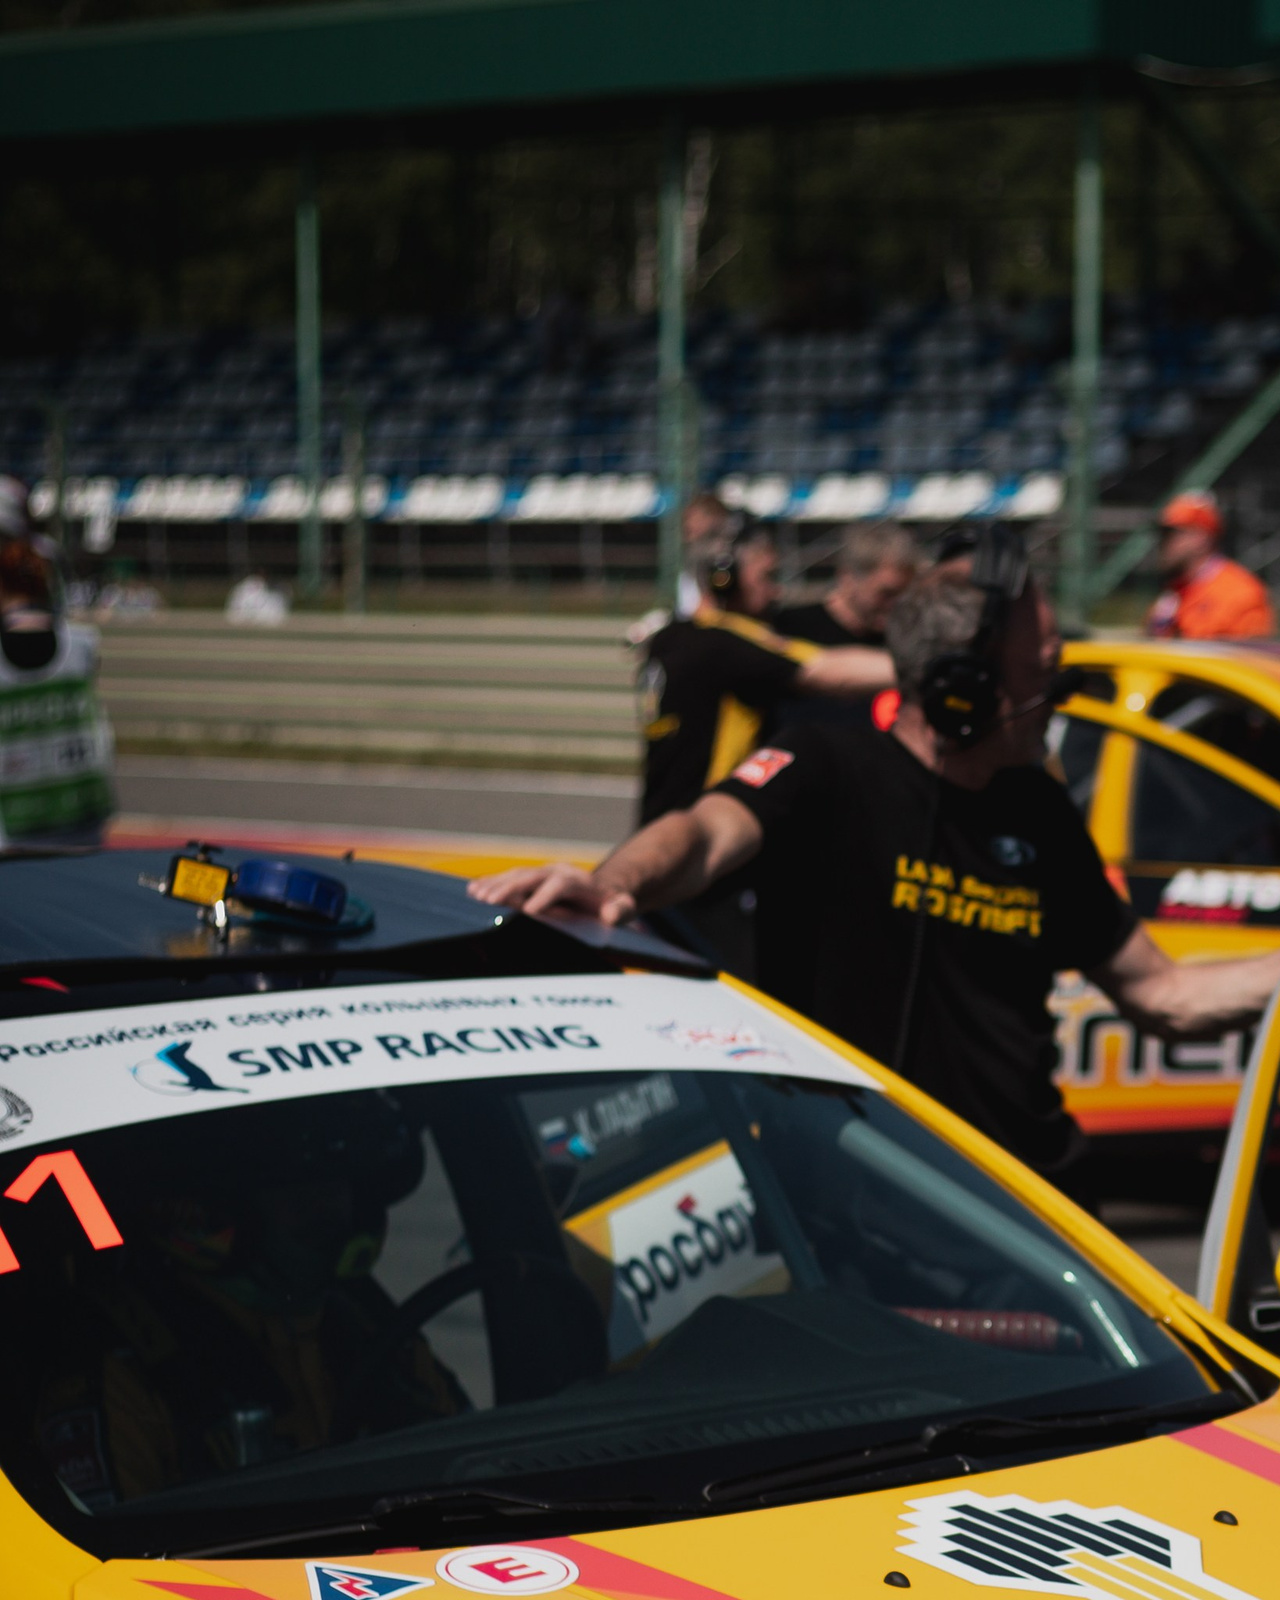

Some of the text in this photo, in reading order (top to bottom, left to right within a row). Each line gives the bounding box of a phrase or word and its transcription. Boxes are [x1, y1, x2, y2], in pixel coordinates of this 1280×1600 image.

[0, 1018, 218, 1062] Российская
[227, 1005, 332, 1029] серия
[227, 1038, 363, 1077] SMP
[375, 1025, 601, 1060] RACING
[468, 1556, 548, 1585] E
